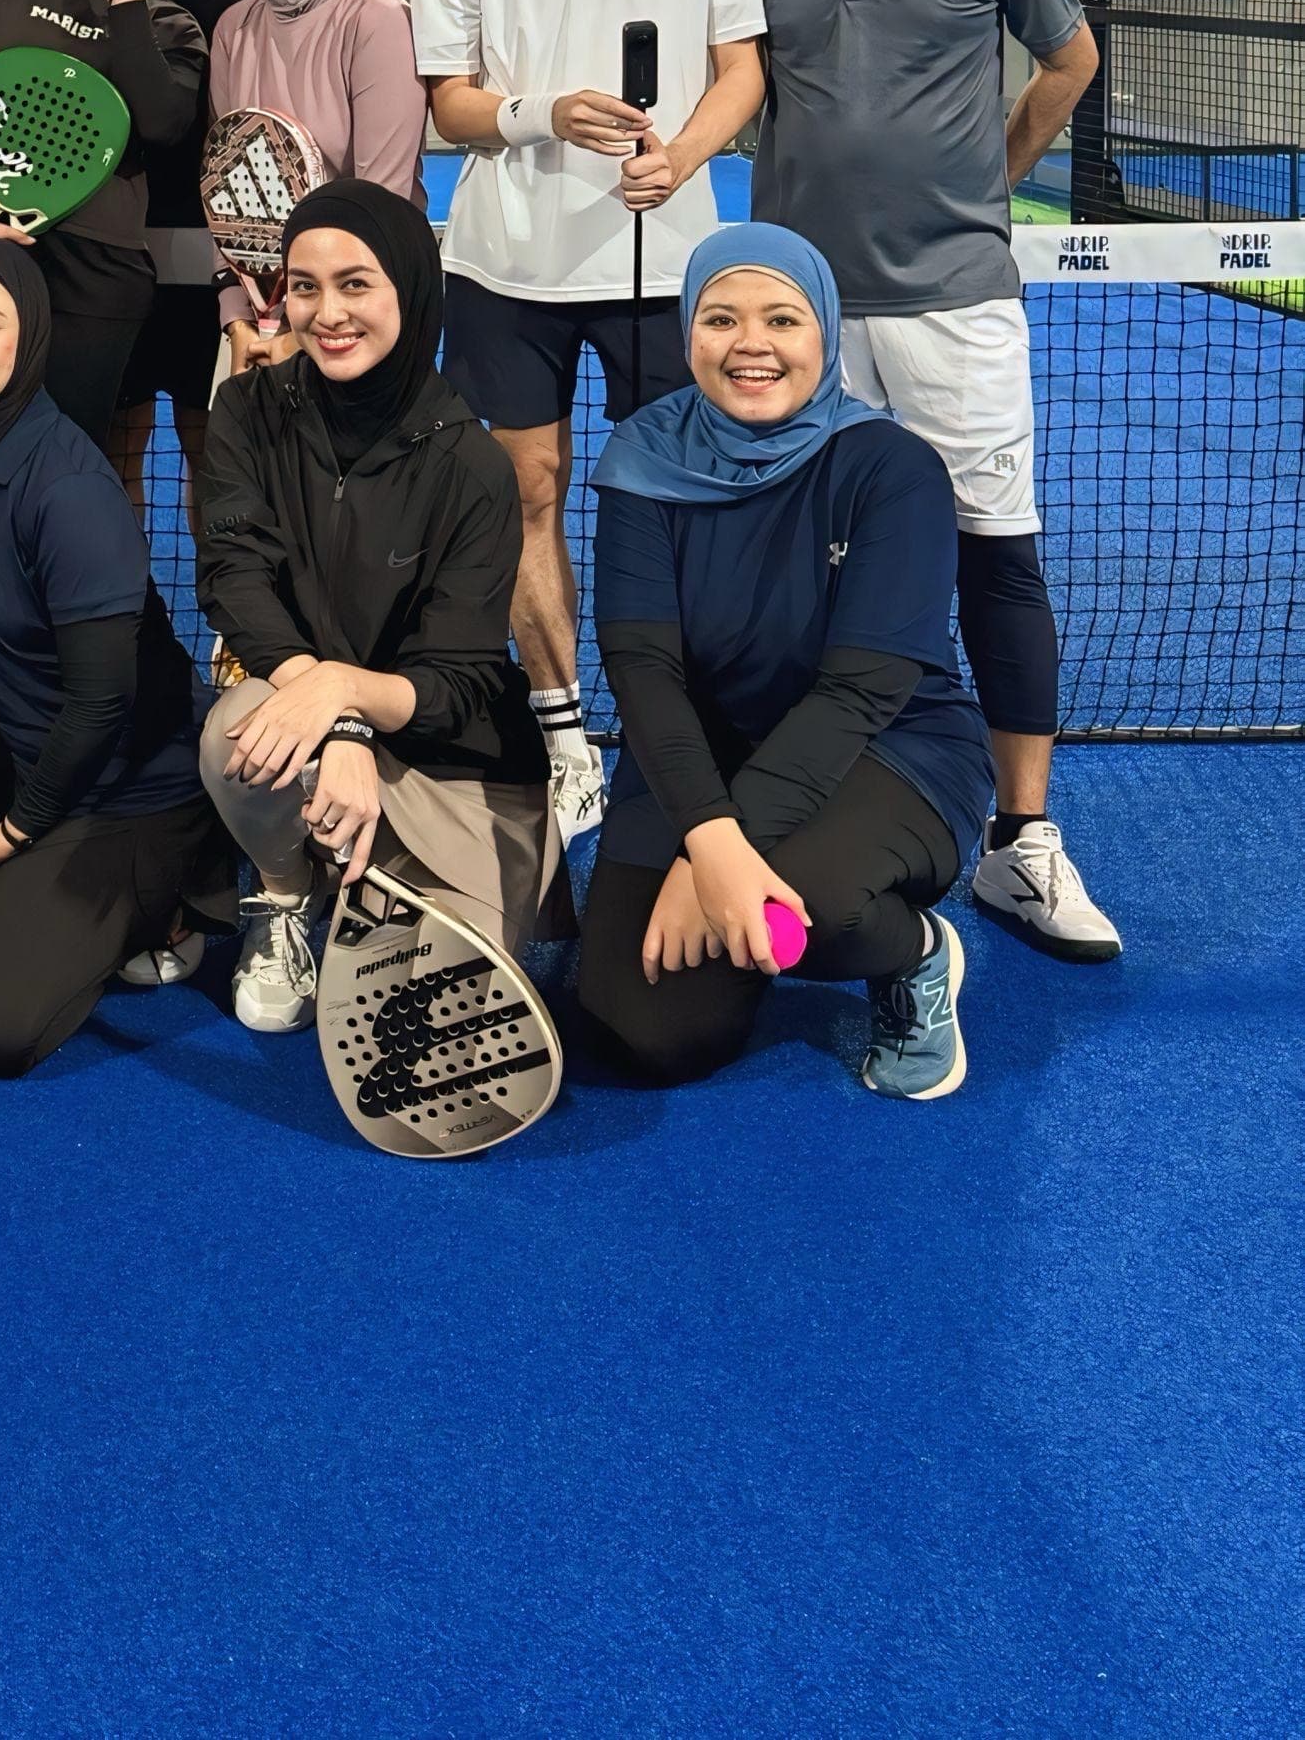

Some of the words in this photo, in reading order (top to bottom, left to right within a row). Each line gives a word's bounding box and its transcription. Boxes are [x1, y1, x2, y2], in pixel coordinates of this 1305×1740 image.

[30, 5, 104, 40] MARIST
[1058, 255, 1110, 271] PADEL
[1220, 253, 1271, 269] PADEL
[329, 720, 374, 738] Bullpa
[356, 943, 432, 979] Bullpadel
